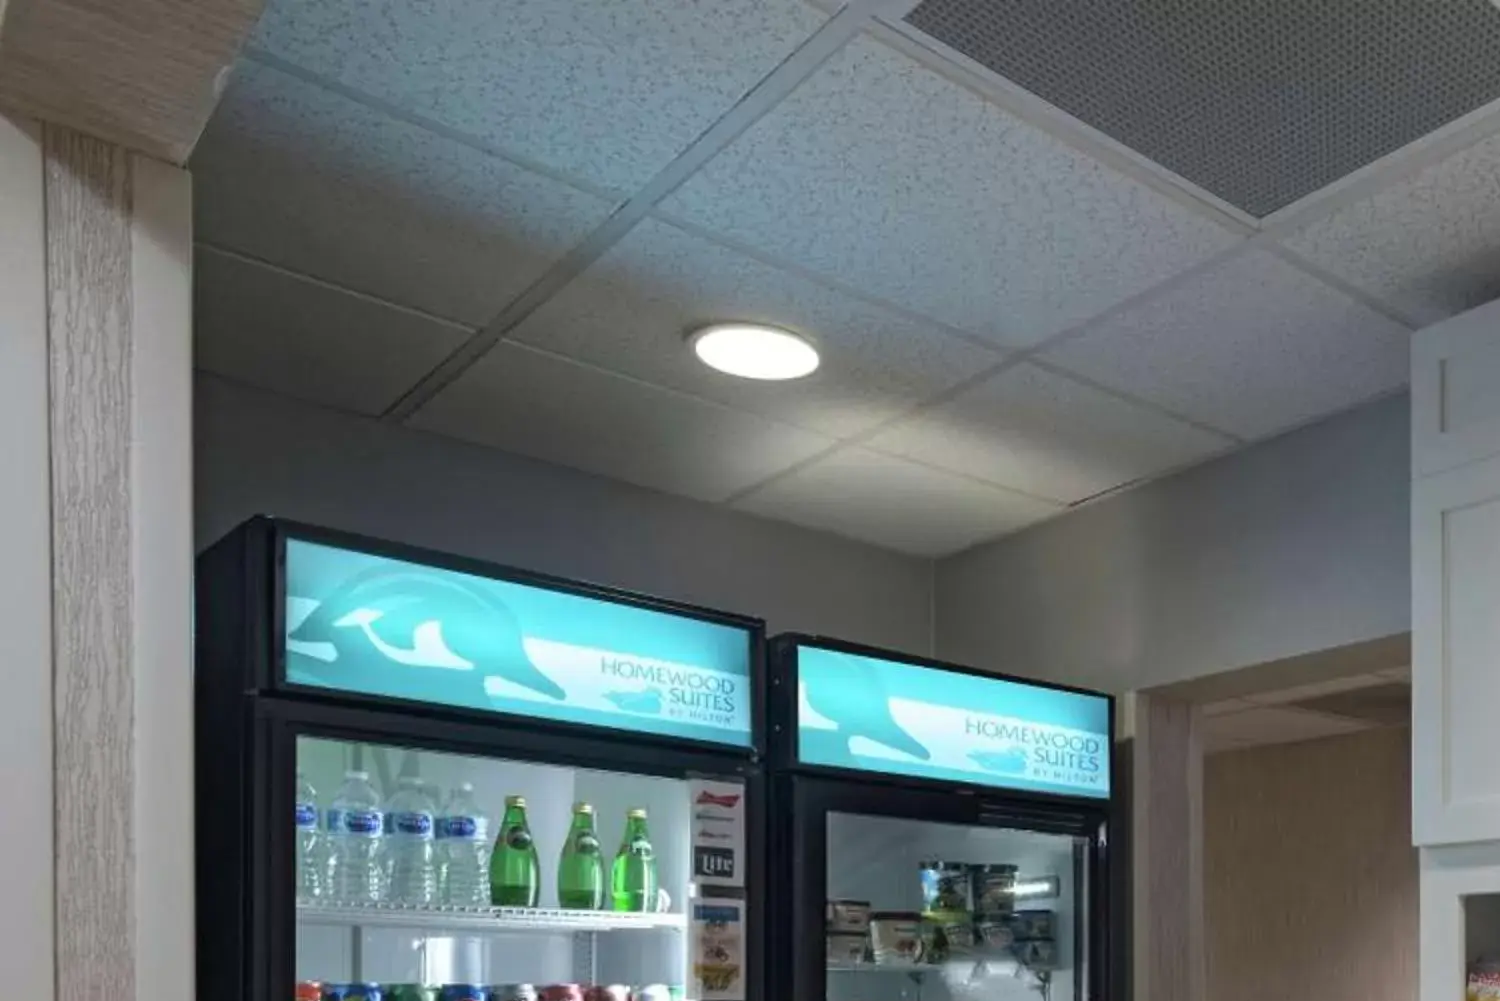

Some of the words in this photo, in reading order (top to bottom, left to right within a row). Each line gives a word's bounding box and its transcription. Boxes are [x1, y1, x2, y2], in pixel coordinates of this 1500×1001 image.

[600, 656, 736, 696] HOMEWOOD
[668, 687, 736, 713] SUITES
[964, 716, 1100, 755] HOMEWOOD
[1033, 747, 1100, 773] SUITES
[1033, 767, 1048, 778] BY
[1053, 770, 1098, 784] HILTON
